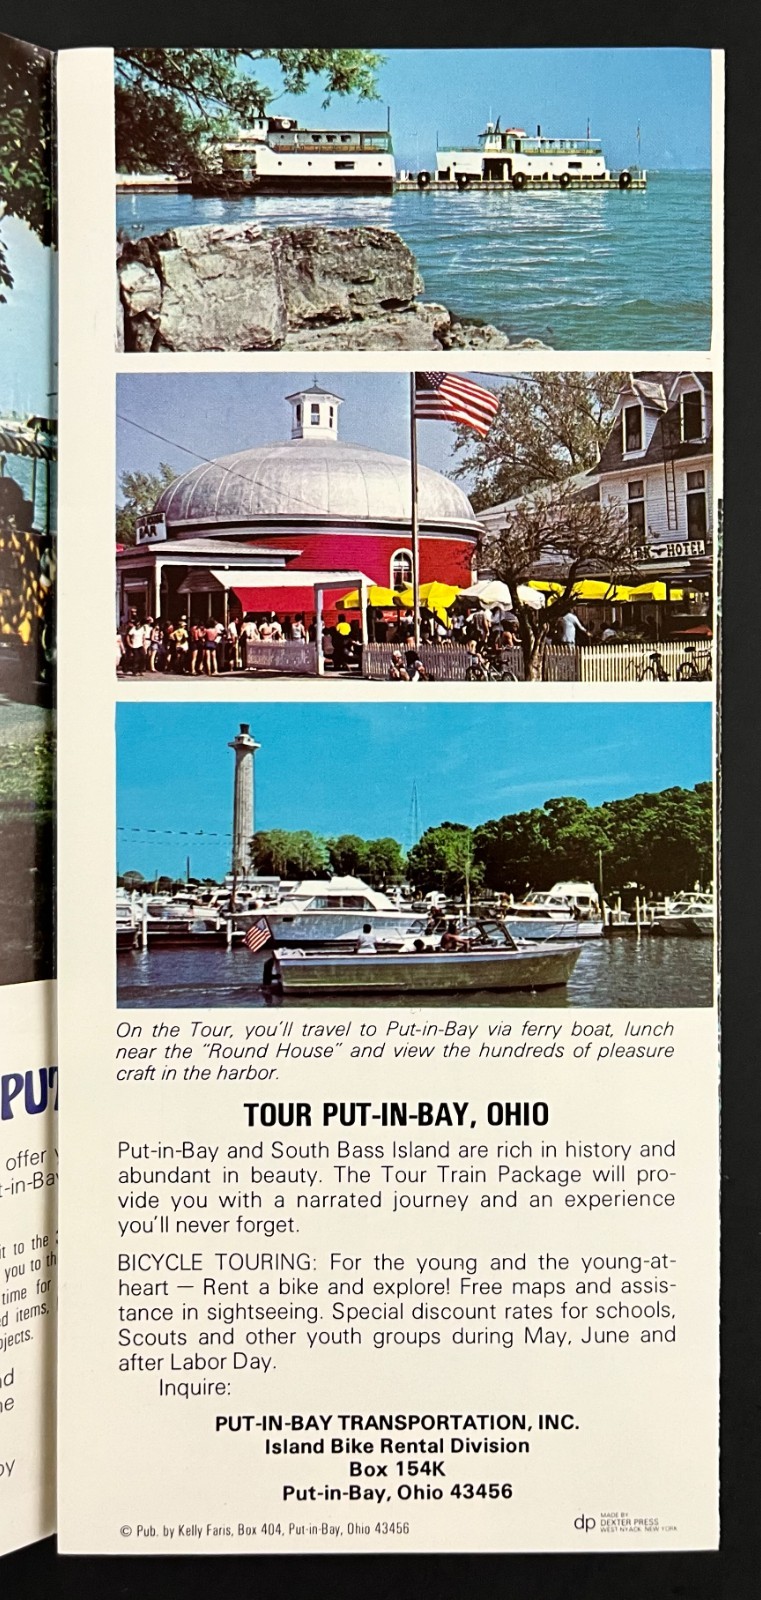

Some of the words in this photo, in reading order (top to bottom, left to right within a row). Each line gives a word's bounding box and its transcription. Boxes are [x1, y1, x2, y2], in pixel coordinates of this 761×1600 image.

[666, 541, 704, 557] HOTEL
[116, 1021, 143, 1039] On
[151, 1021, 181, 1038] the
[190, 1020, 234, 1039] Tour,
[245, 1020, 294, 1040] you'll
[301, 1020, 353, 1038] travel
[359, 1022, 378, 1037] to
[385, 1020, 479, 1040] Put-in-Bay
[488, 1020, 513, 1037] via
[521, 1020, 563, 1040] ferry
[570, 1020, 614, 1039] boat,
[624, 1020, 675, 1037] lunch
[115, 1047, 158, 1060] near
[164, 1042, 193, 1060] the
[202, 1042, 270, 1060] "Round
[275, 1041, 344, 1059] House"
[349, 1041, 387, 1059] and
[393, 1041, 436, 1058] view
[442, 1041, 471, 1058] the
[478, 1041, 565, 1059] hundreds
[572, 1041, 593, 1059] of
[596, 1041, 675, 1062] pleasure
[116, 1064, 157, 1082] craft
[160, 1064, 178, 1081] in
[183, 1064, 212, 1081] the
[215, 1064, 279, 1081] harbor.
[242, 1102, 312, 1128] TOUR
[322, 1101, 477, 1130] PUT-IN-BAY,
[486, 1101, 549, 1127] OHIO
[5, 1149, 47, 1171] offer
[118, 1140, 220, 1163] Put-in-Bay
[226, 1140, 264, 1160] and
[271, 1140, 330, 1160] South
[337, 1140, 385, 1159] Bass
[392, 1140, 450, 1159] Island
[458, 1144, 489, 1159] are
[496, 1139, 533, 1159] rich
[541, 1140, 557, 1159] in
[565, 1140, 632, 1162] history
[639, 1139, 676, 1158] and
[118, 1165, 212, 1185] abundant
[222, 1165, 239, 1184] in
[250, 1165, 323, 1188] beauty.
[332, 1165, 371, 1184] The
[380, 1164, 428, 1184] Tour
[436, 1164, 487, 1184] Train
[498, 1164, 582, 1188] Package
[592, 1164, 625, 1183] will
[637, 1168, 677, 1187] pro-
[117, 1190, 160, 1209] vide
[170, 1194, 208, 1213] you
[218, 1190, 262, 1209] with
[273, 1194, 285, 1209] a
[296, 1190, 382, 1209] narrated
[392, 1189, 469, 1213] journey
[480, 1189, 518, 1209] and
[529, 1194, 553, 1208] an
[564, 1189, 676, 1212] experience
[117, 1214, 169, 1238] you'll
[176, 1219, 231, 1234] never
[235, 1214, 300, 1238] forget.
[13, 1242, 25, 1256] to
[31, 1233, 49, 1251] the
[4, 1263, 26, 1283] you
[30, 1258, 42, 1272] to
[117, 1252, 204, 1272] BICYCLE
[214, 1252, 317, 1272] TOURING:
[330, 1252, 363, 1271] For
[373, 1252, 405, 1272] the
[415, 1257, 478, 1276] young
[489, 1252, 527, 1271] and
[537, 1252, 570, 1271] the
[580, 1253, 677, 1274] young-at-
[2, 1287, 27, 1305] time
[36, 1278, 52, 1295] for
[118, 1278, 169, 1297] heart
[203, 1277, 250, 1296] Rent
[258, 1281, 270, 1296] a
[278, 1276, 319, 1296] bike
[327, 1276, 364, 1296] and
[372, 1276, 450, 1300] explore!
[460, 1276, 503, 1296] Free
[512, 1281, 566, 1299] maps
[575, 1276, 612, 1295] and
[620, 1275, 677, 1295] assis-
[16, 1301, 50, 1323] items,
[117, 1305, 174, 1322] tance
[182, 1302, 199, 1321] in
[206, 1301, 324, 1325] sightseeing.
[332, 1301, 404, 1324] Special
[411, 1301, 497, 1321] discount
[504, 1303, 553, 1320] rates
[560, 1300, 589, 1320] for
[595, 1300, 676, 1320] schools,
[117, 1327, 188, 1347] Scouts
[198, 1326, 235, 1346] and
[245, 1326, 297, 1346] other
[306, 1326, 362, 1349] youth
[372, 1331, 441, 1349] groups
[451, 1326, 514, 1349] during
[524, 1325, 572, 1348] May,
[580, 1325, 630, 1344] June
[639, 1324, 676, 1344] and
[118, 1352, 165, 1372] after
[170, 1351, 228, 1371] Labor
[233, 1351, 277, 1374] Day.
[159, 1377, 231, 1399] Inquire:
[215, 1414, 334, 1433] PUT-IN-BAY
[336, 1413, 533, 1433] TRANSPORTATION,
[538, 1413, 580, 1431] INC.
[265, 1437, 325, 1456] Island
[330, 1437, 375, 1455] Bike
[380, 1437, 444, 1455] Rental
[450, 1436, 530, 1454] Division
[349, 1460, 389, 1478] Box
[395, 1459, 447, 1478] 154K
[282, 1483, 392, 1505] Put-in-Bay,
[396, 1483, 444, 1501] Ohio
[449, 1482, 513, 1500] 43456
[136, 1524, 159, 1538] Pub.
[162, 1524, 175, 1540] by
[177, 1523, 203, 1540] Kelly
[206, 1523, 234, 1537] Faris,
[237, 1522, 257, 1537] Box
[260, 1522, 285, 1537] 404,
[288, 1522, 344, 1538] Put-in-Bay,
[347, 1521, 371, 1536] Ohio
[374, 1521, 410, 1535] 43456
[573, 1513, 597, 1533] dp
[600, 1518, 632, 1526] DEXTER
[633, 1518, 660, 1526] PRESS
